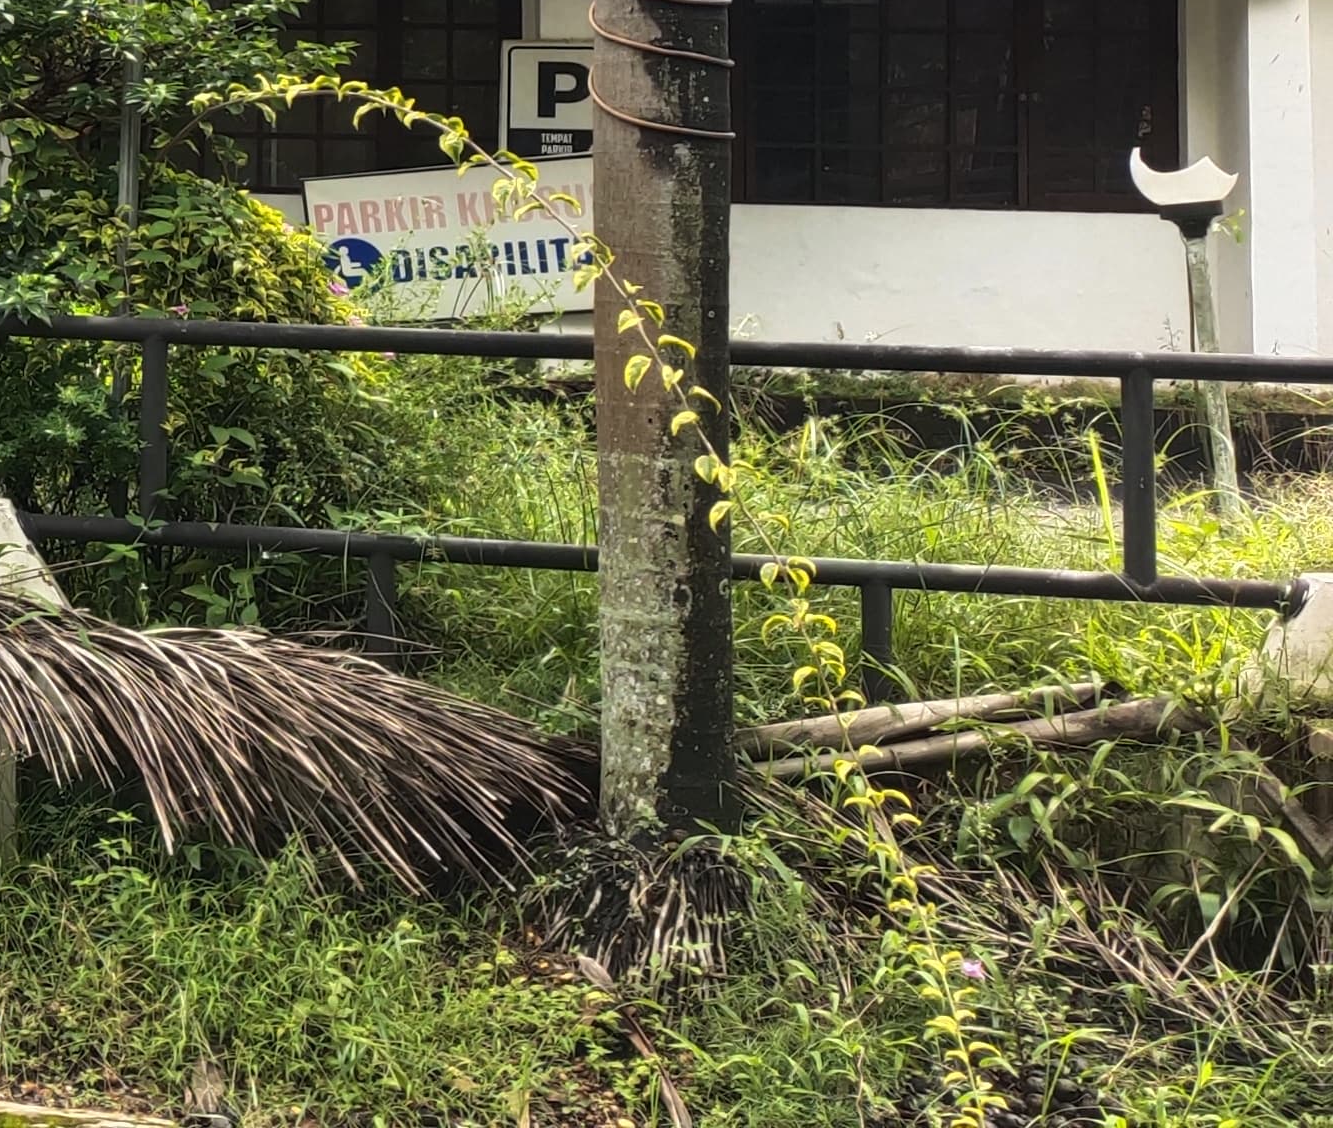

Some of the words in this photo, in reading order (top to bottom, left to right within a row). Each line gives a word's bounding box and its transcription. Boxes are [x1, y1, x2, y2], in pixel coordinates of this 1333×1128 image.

[537, 61, 590, 119] P
[541, 133, 573, 144] TEMPAT
[313, 195, 447, 236] PARKIR
